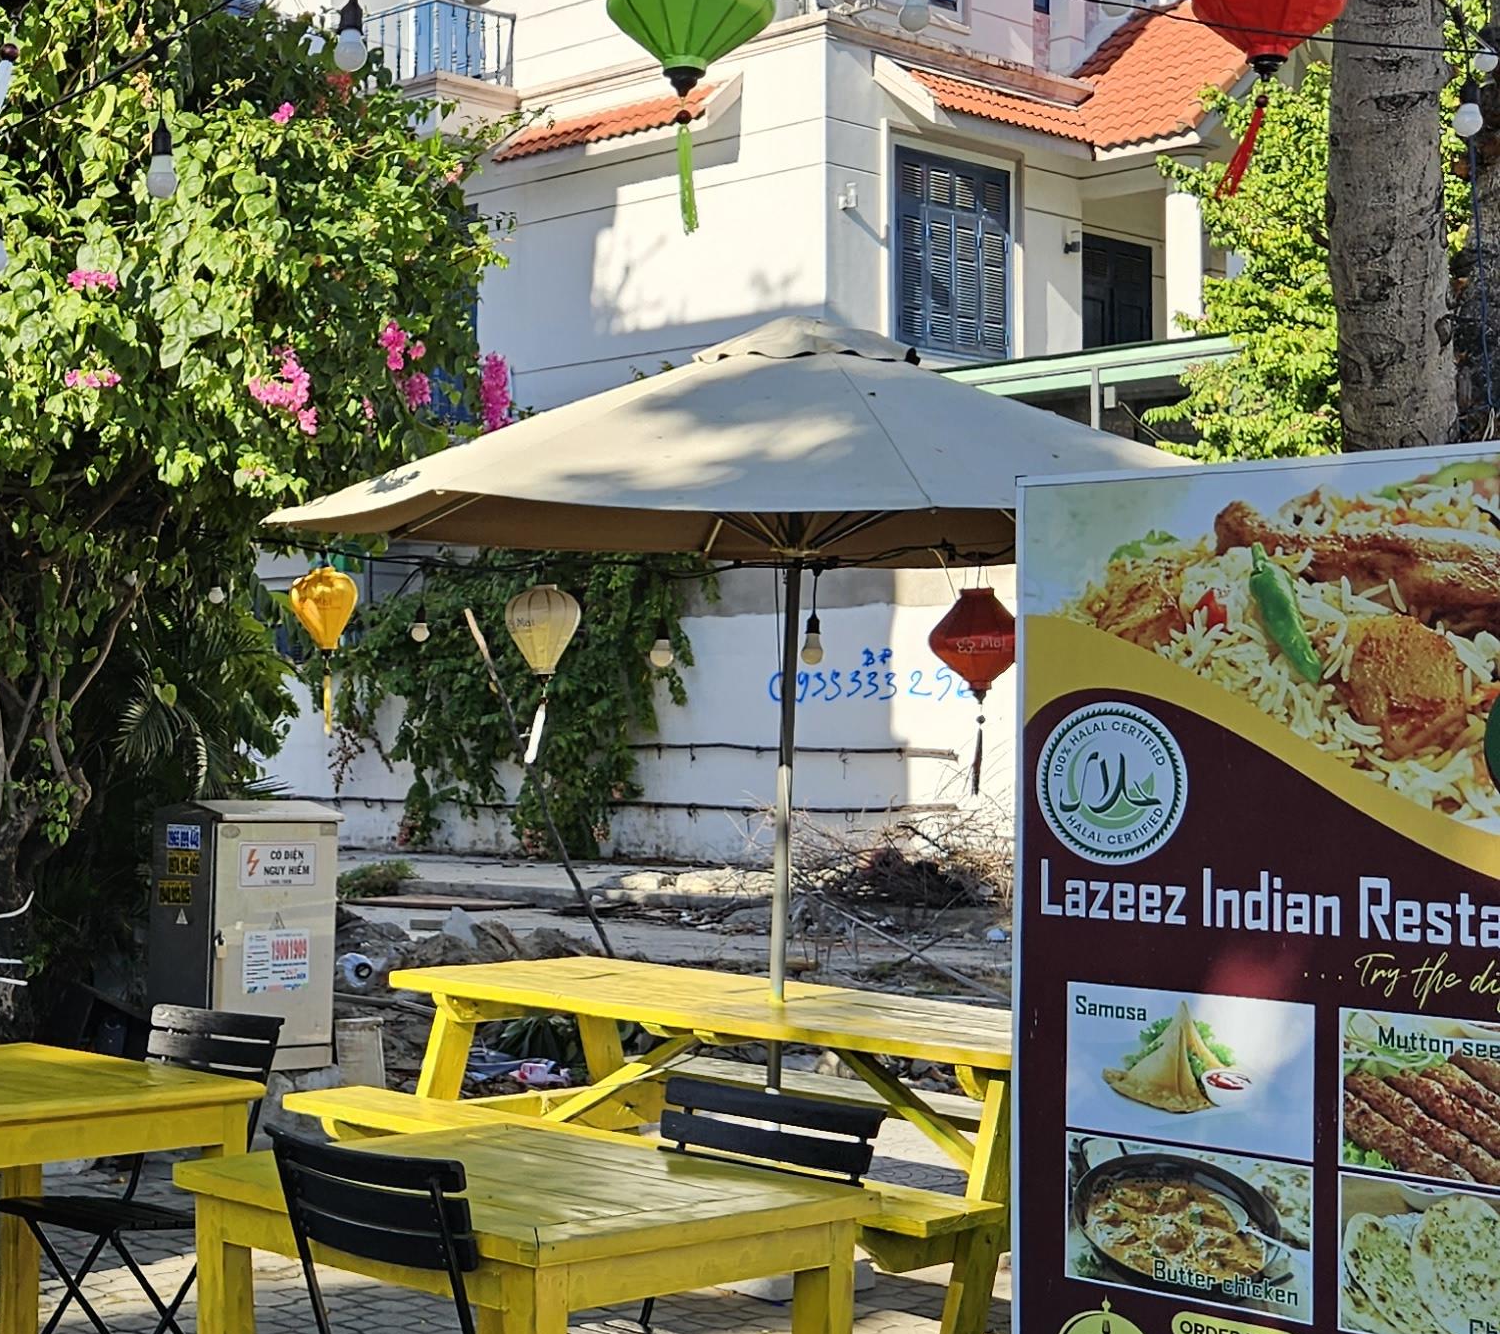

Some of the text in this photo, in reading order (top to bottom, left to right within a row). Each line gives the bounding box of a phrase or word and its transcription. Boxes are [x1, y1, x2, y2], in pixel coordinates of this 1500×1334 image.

[1053, 720, 1166, 778] 100% HALAL CERTIFIED
[1066, 806, 1164, 845] HALAL CERTIFIED
[1040, 858, 1500, 948] Lazeez Indian Resta
[1355, 952, 1405, 998] Try
[1411, 951, 1463, 1010] the
[1075, 994, 1148, 1023] Samosa
[1377, 1025, 1454, 1055] Mutton
[1152, 1259, 1299, 1307] Butter chicken
